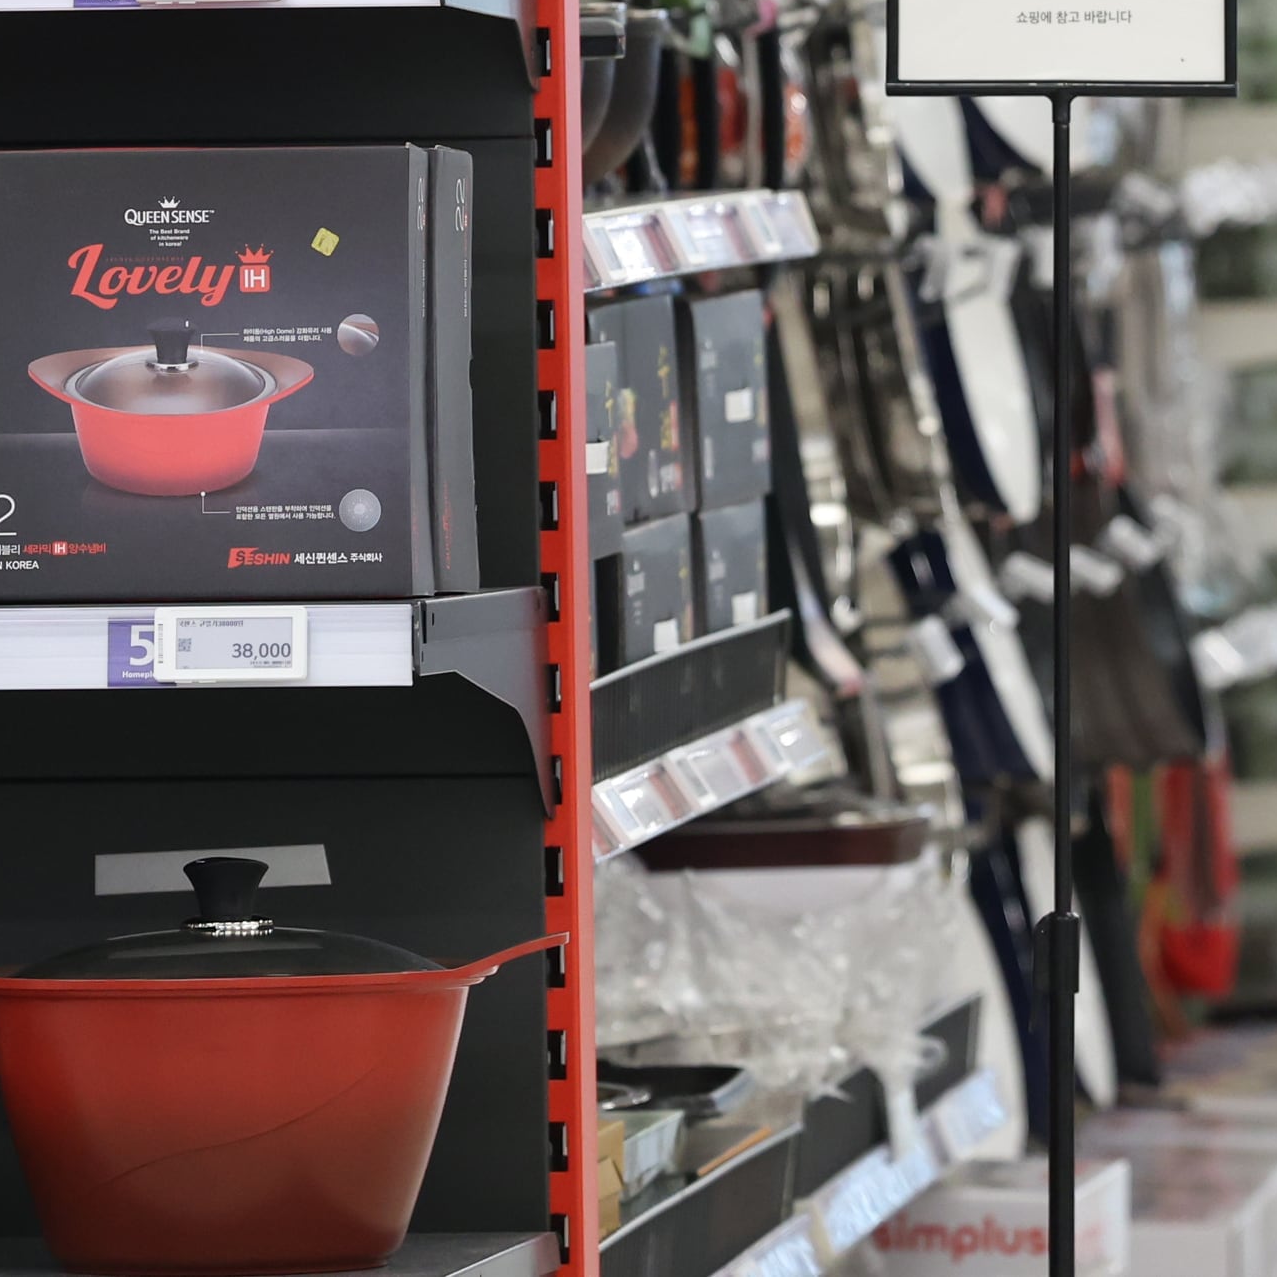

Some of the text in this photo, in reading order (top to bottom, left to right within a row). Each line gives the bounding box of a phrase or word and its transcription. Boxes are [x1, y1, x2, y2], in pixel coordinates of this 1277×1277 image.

[1016, 9, 1132, 24] 쇼핑에 참고 바랍니다
[124, 209, 209, 226] QUEEN SENSE
[67, 243, 265, 310] Lovely IH
[292, 512, 304, 520] 사용
[22, 544, 51, 555] 세라믹
[231, 548, 382, 566] SESHIN 세신퀸센스 주식회사
[5, 561, 39, 570] KOREA
[129, 625, 155, 666] 5
[232, 643, 291, 660] 38,000
[122, 670, 153, 679] Homepl
